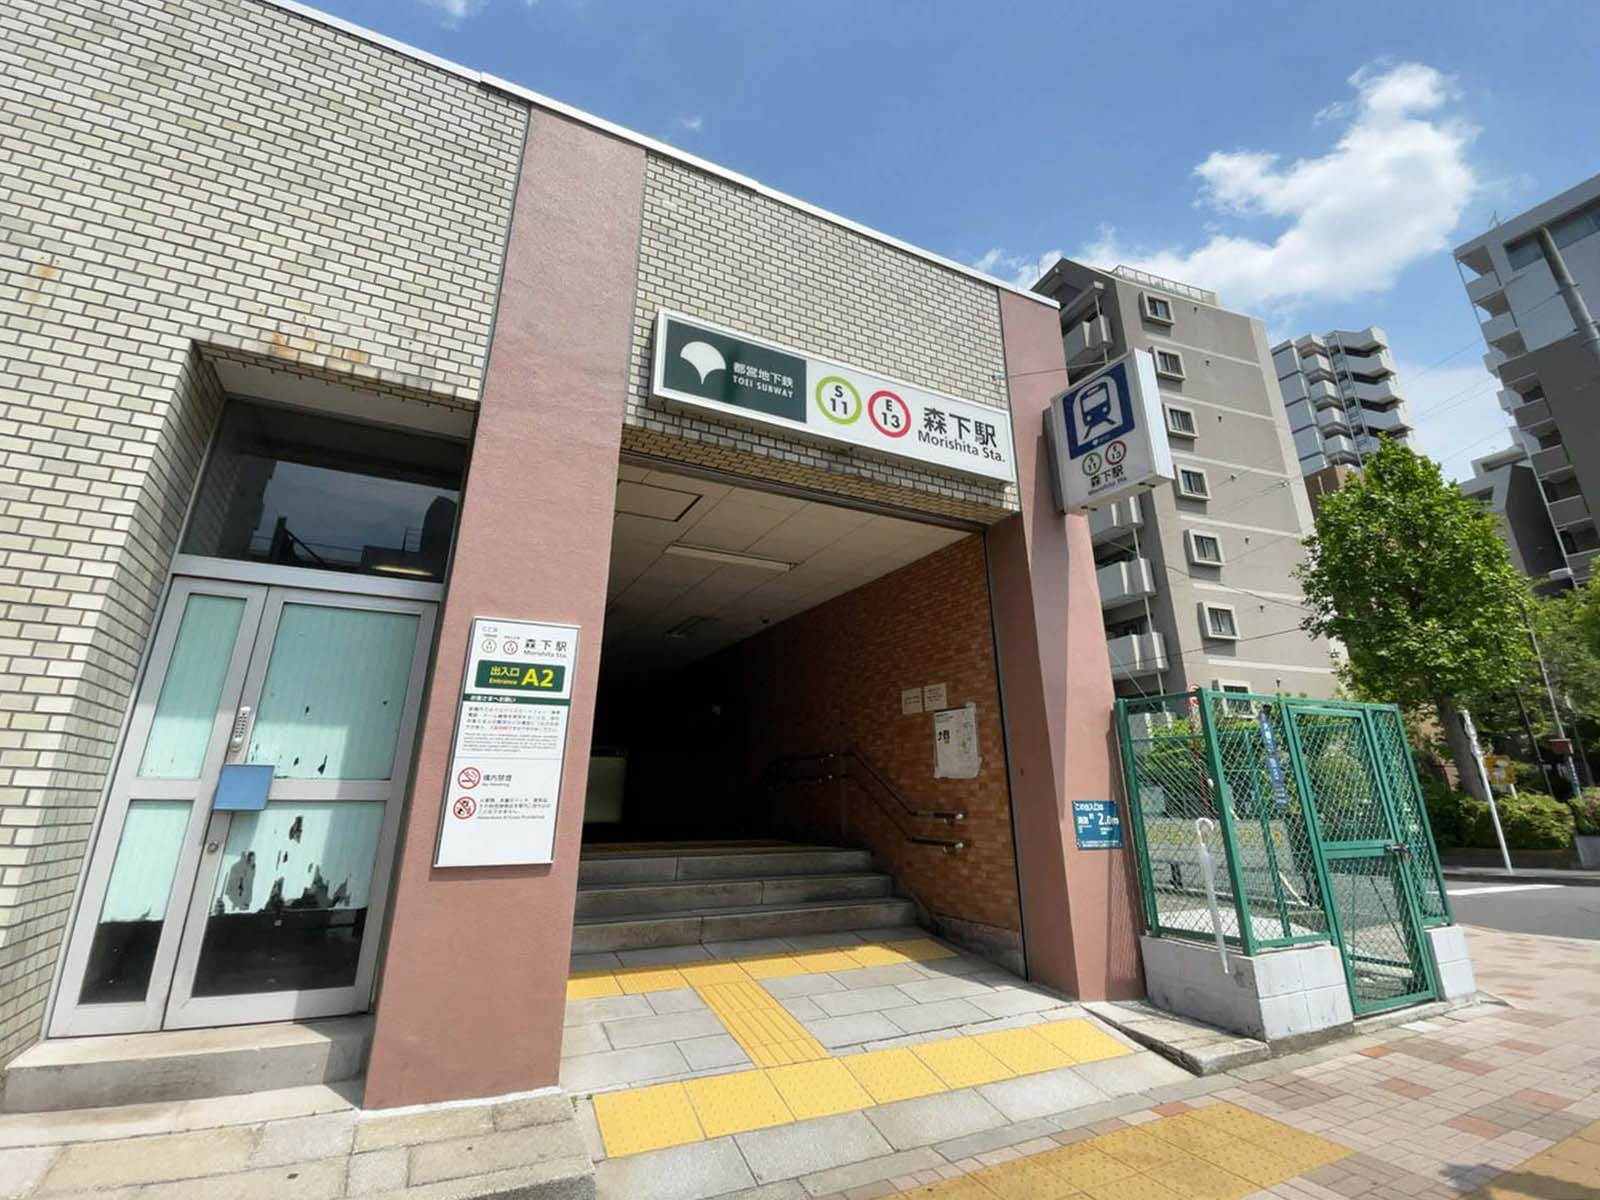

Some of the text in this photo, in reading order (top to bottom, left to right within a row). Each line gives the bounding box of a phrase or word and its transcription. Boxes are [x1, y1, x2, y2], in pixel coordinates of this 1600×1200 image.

[733, 362, 793, 388] 都営地下鉄
[757, 382, 793, 398] SUBWAY
[834, 385, 843, 398] S
[830, 398, 847, 415] 11
[886, 399, 893, 412] E
[882, 412, 900, 428] 13
[923, 407, 997, 448] 森下駅
[918, 430, 1006, 462] Morishita Sta.
[1091, 464, 1123, 488] 森下駅
[526, 639, 567, 652] 森下駅
[490, 665, 520, 677] 出入口
[521, 668, 554, 687] A2
